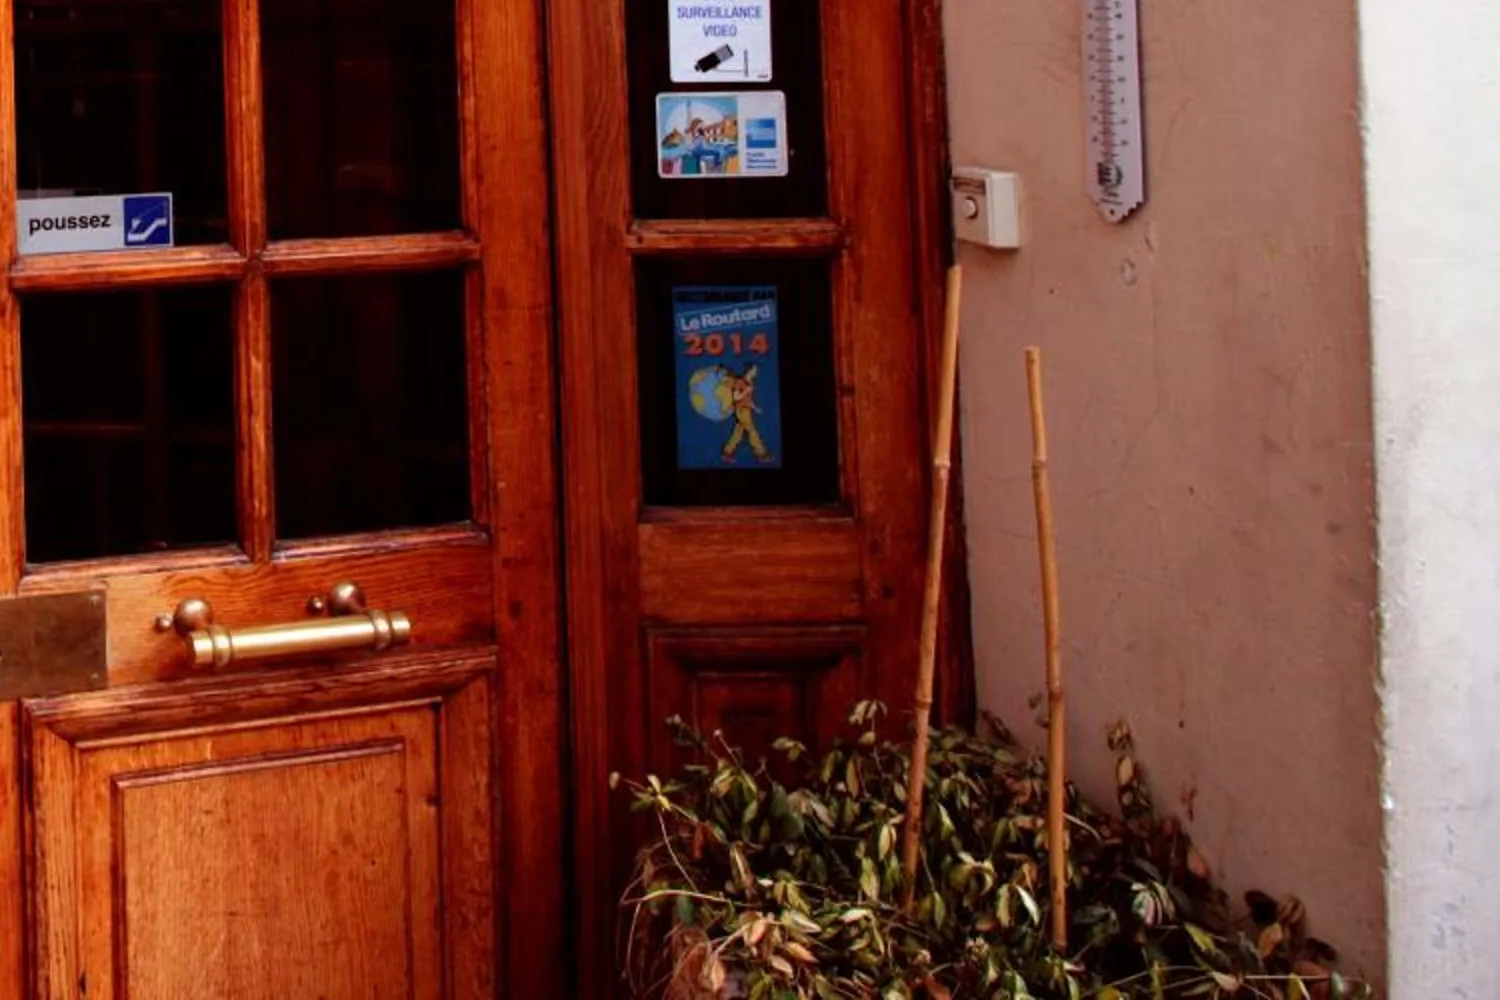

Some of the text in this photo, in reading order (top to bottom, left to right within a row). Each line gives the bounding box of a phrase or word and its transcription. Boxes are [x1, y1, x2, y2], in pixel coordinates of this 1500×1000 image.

[676, 5, 763, 19] SURVEILLANCE
[703, 23, 738, 37] VIDEO
[29, 214, 112, 237] poussez
[680, 303, 772, 332] Le Routard
[683, 333, 770, 357] 2014
